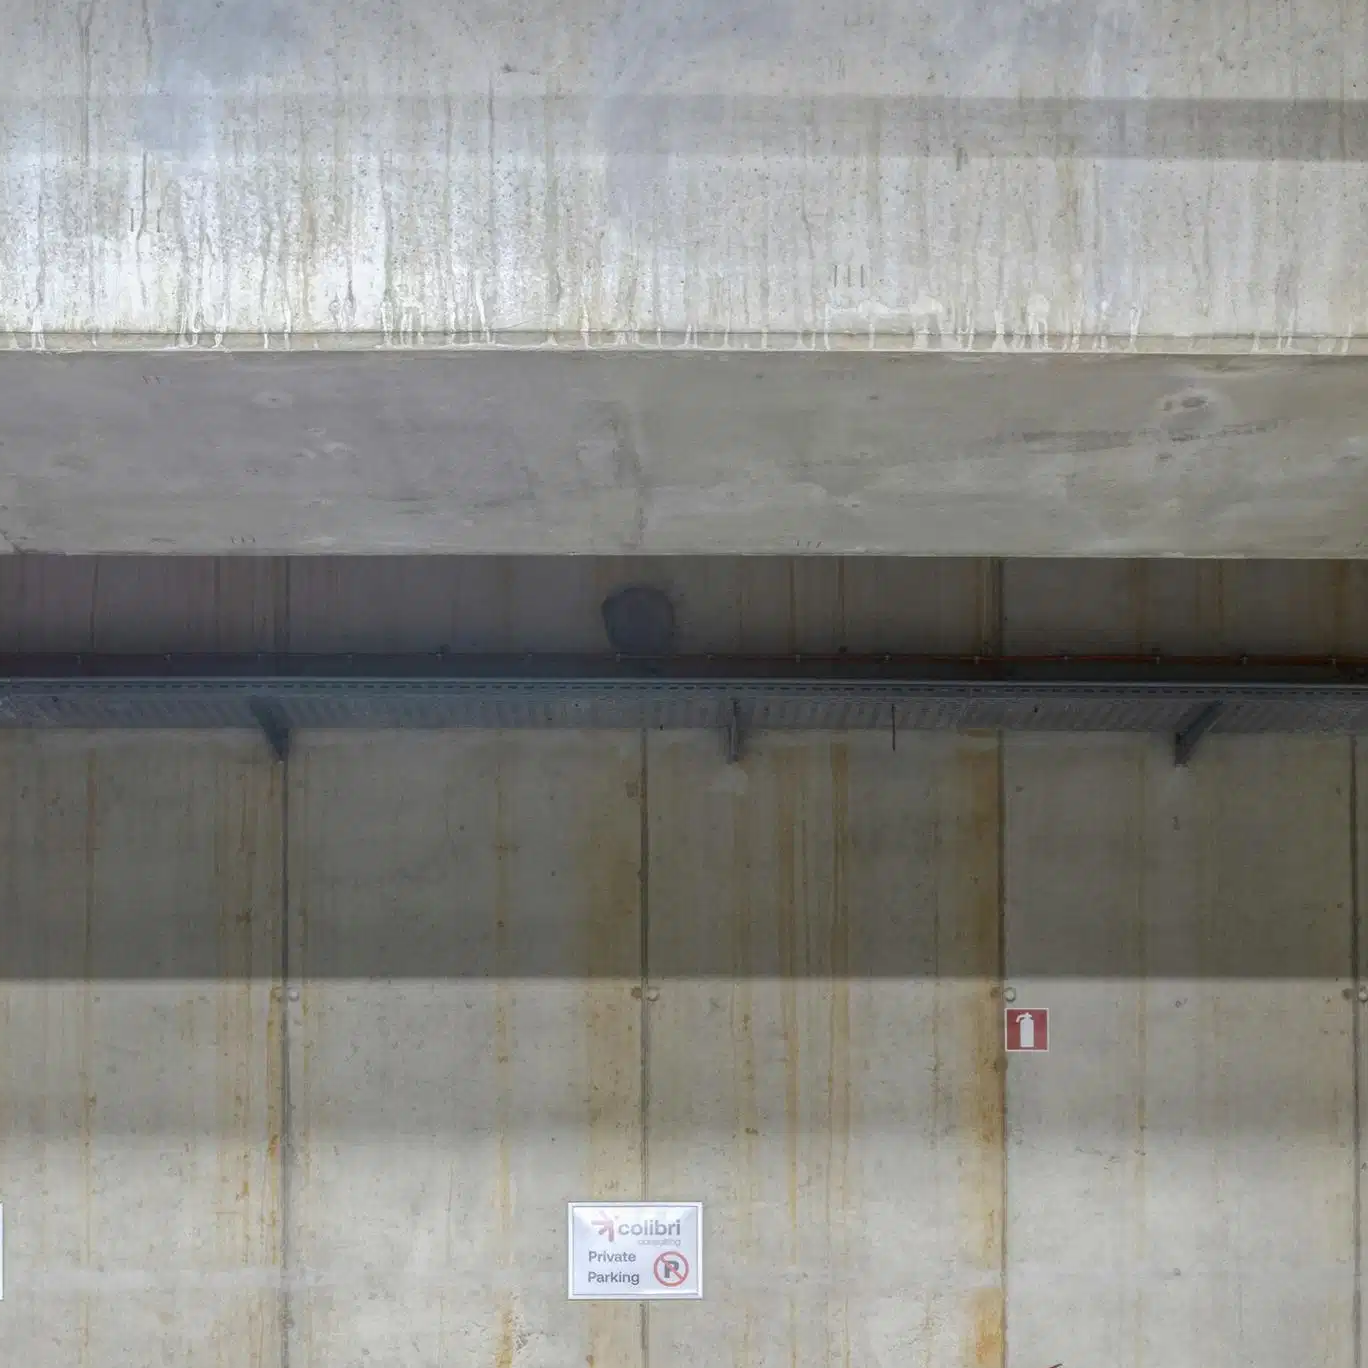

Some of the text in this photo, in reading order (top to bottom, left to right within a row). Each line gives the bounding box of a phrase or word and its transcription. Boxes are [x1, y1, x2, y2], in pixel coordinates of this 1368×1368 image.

[618, 1219, 681, 1236] colibri
[588, 1250, 637, 1263] Private
[587, 1271, 640, 1285] Parking
